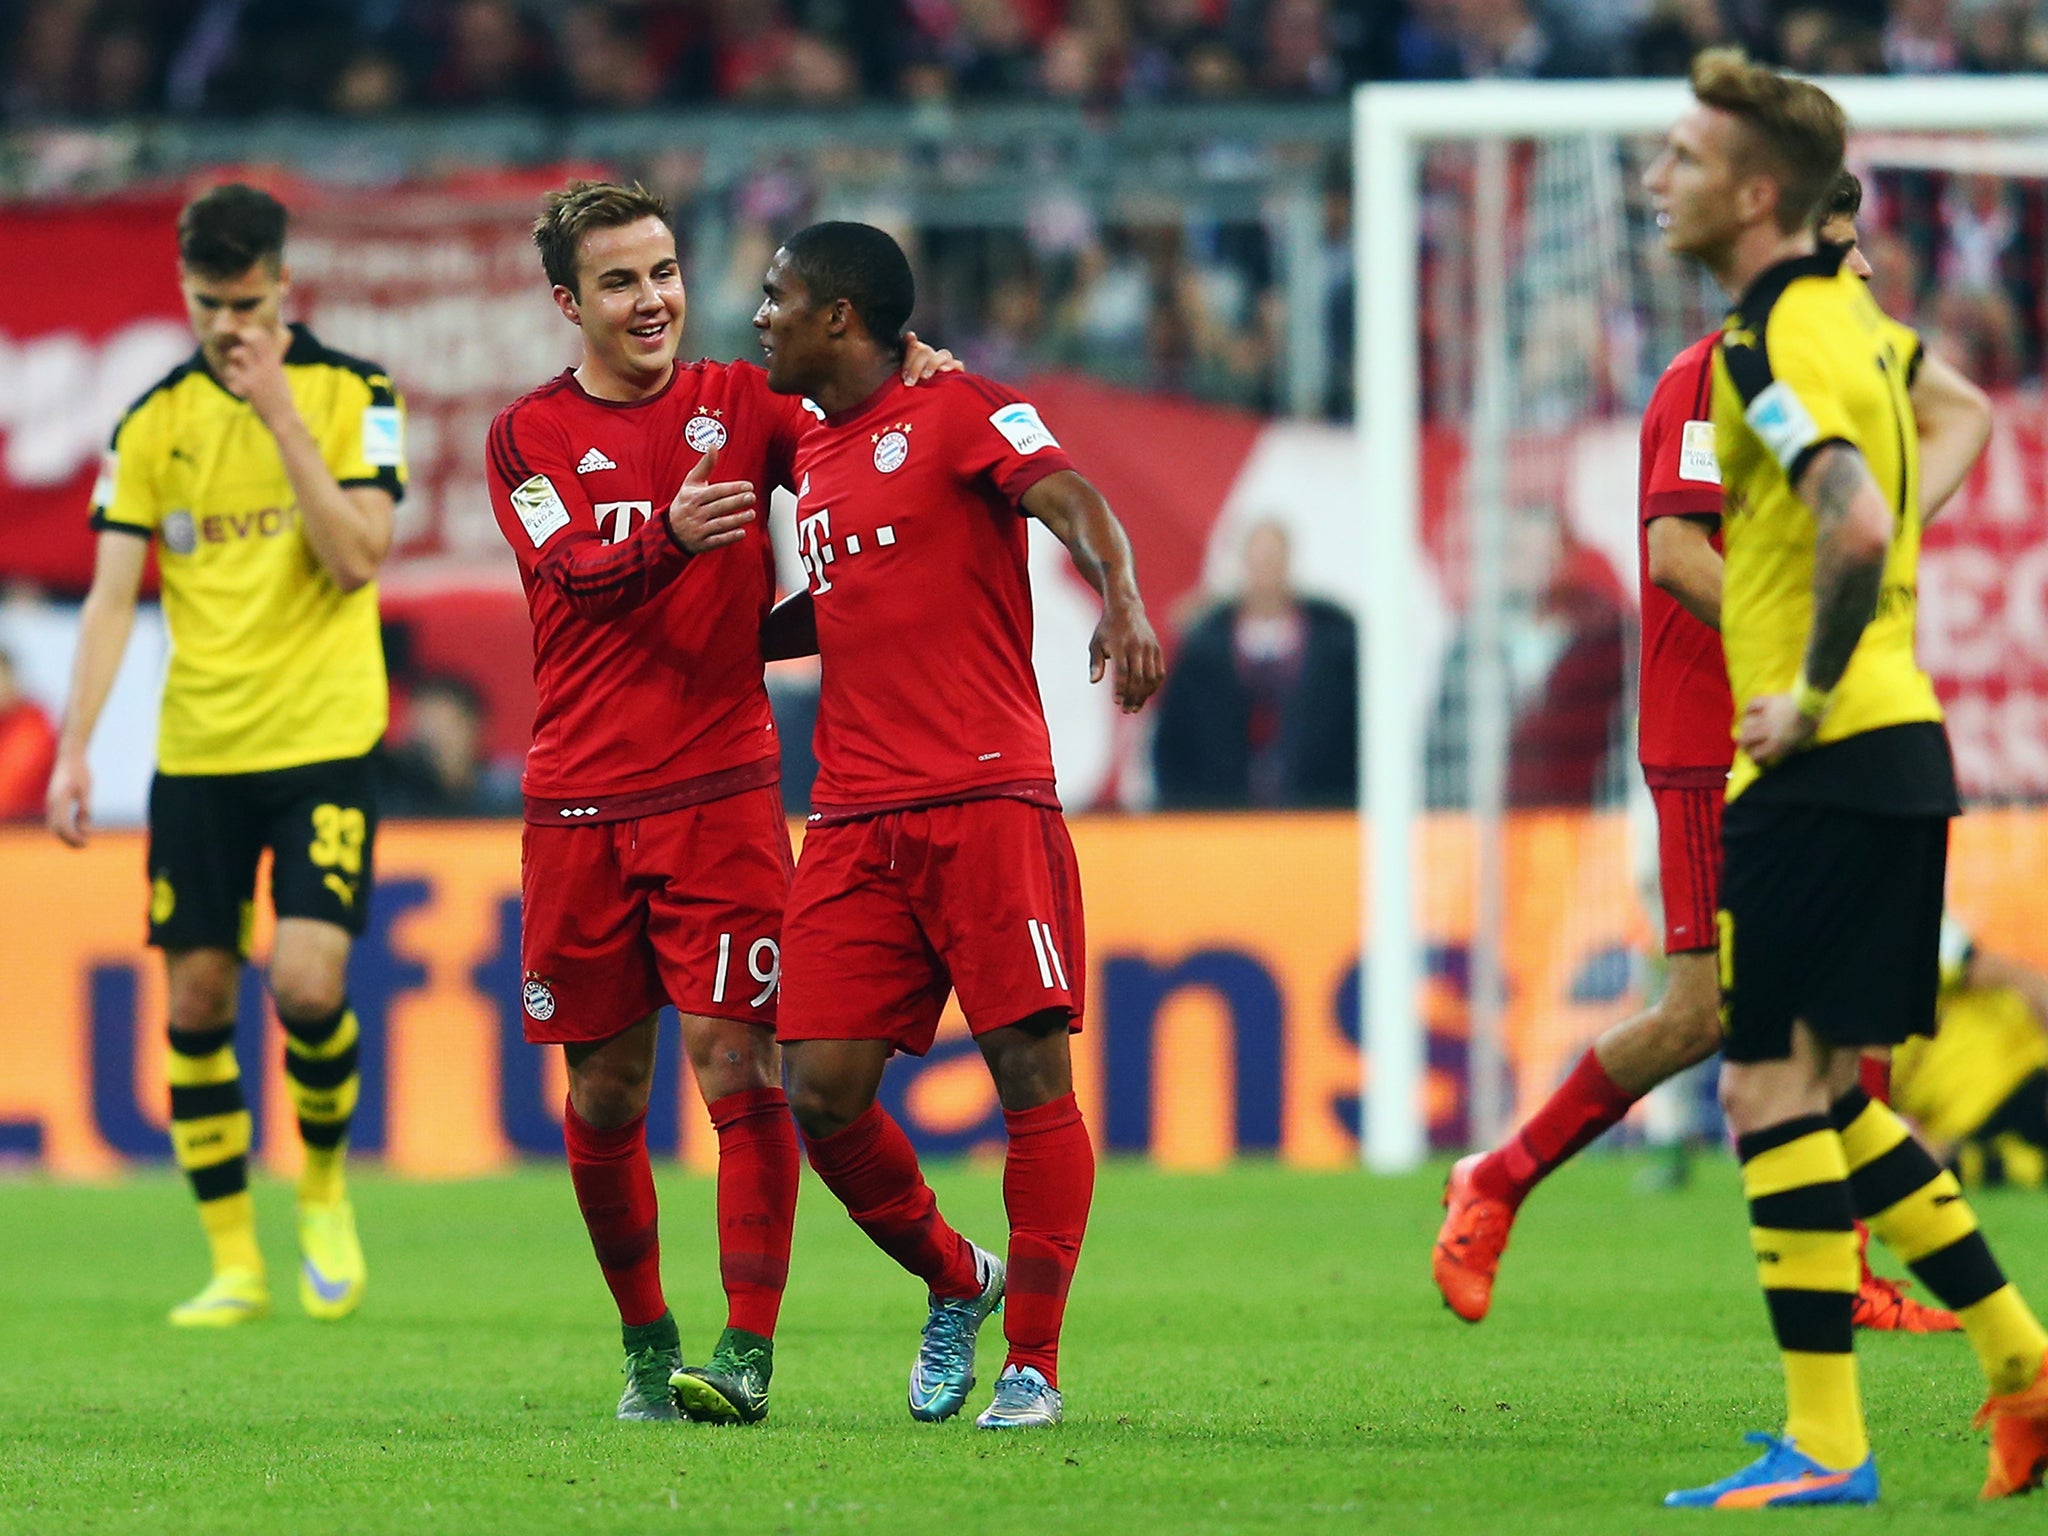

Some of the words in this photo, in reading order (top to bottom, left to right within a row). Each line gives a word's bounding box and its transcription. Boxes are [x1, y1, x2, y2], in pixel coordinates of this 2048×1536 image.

[577, 461, 617, 474] adidas
[525, 497, 559, 527] BUNDES
[533, 509, 555, 529] LIGA
[308, 803, 365, 874] 33
[713, 933, 780, 1008] 19
[1027, 919, 1069, 991] 11
